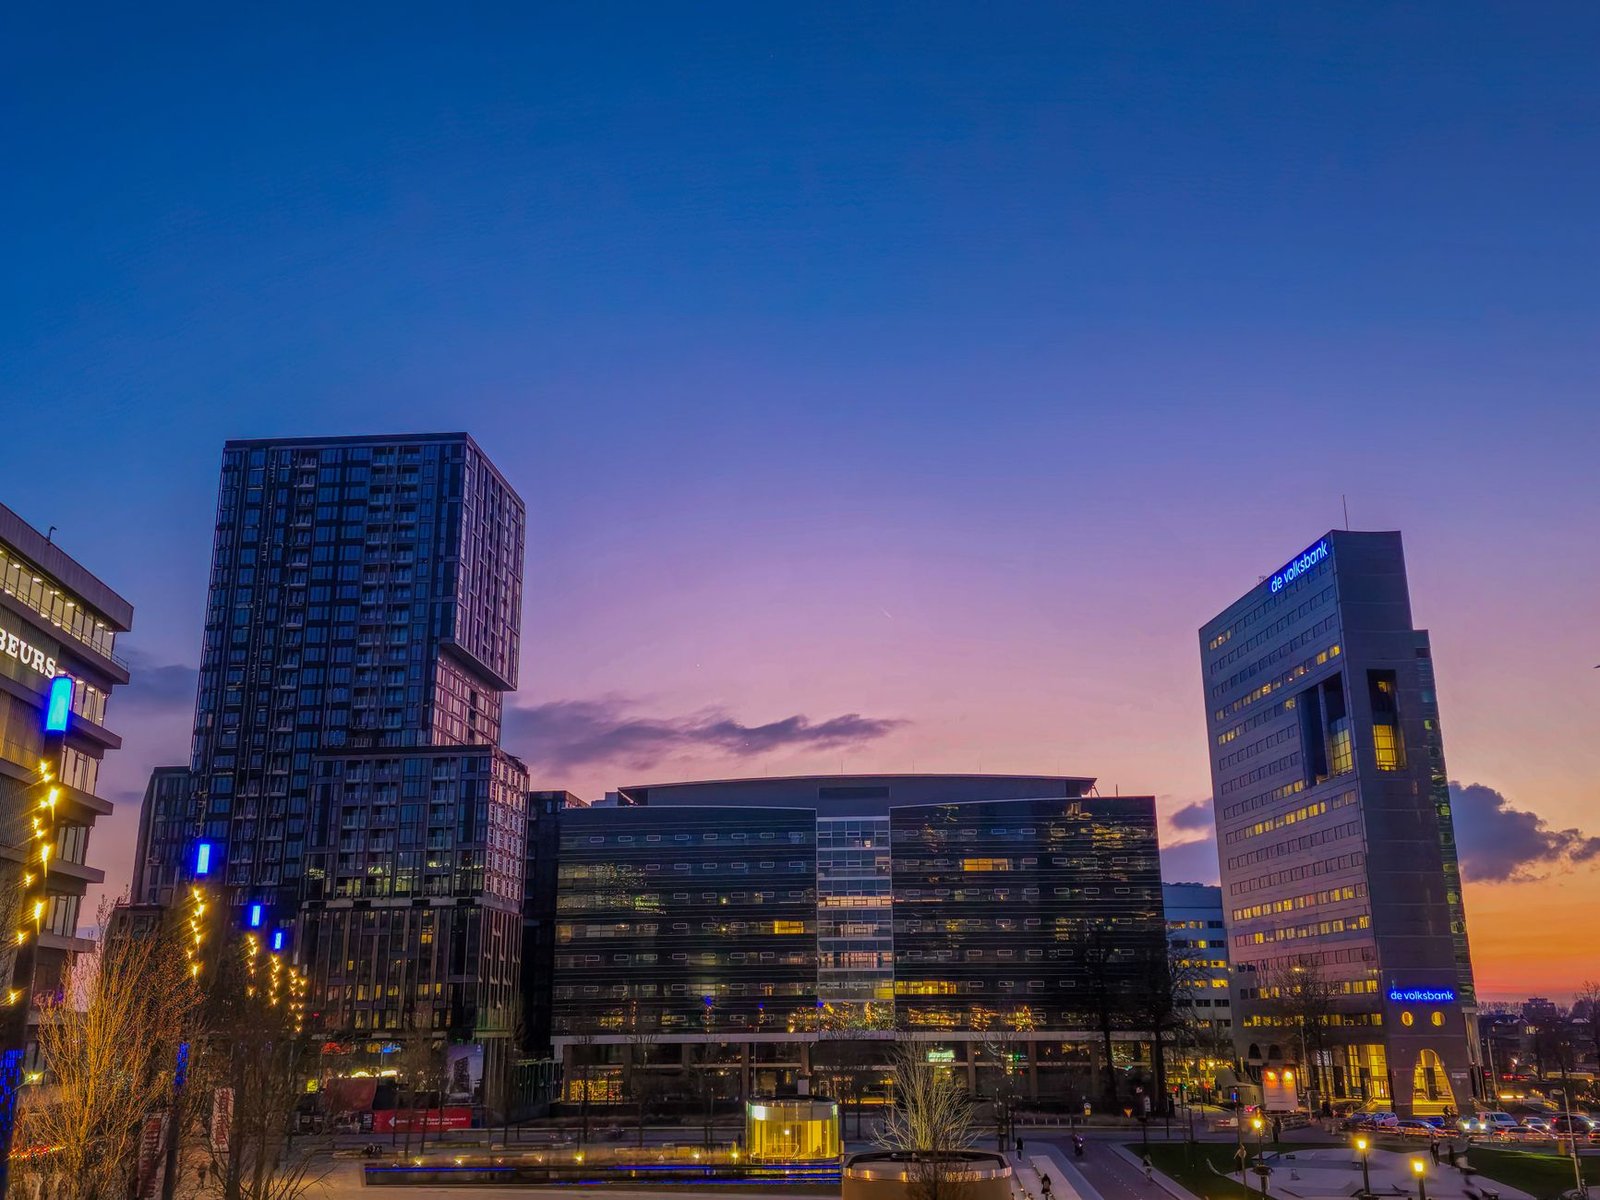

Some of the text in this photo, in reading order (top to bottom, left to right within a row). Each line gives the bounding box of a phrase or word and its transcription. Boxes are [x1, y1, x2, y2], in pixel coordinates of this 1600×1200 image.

[1271, 540, 1328, 593] de volksbank
[1390, 990, 1454, 1000] de volksbank
